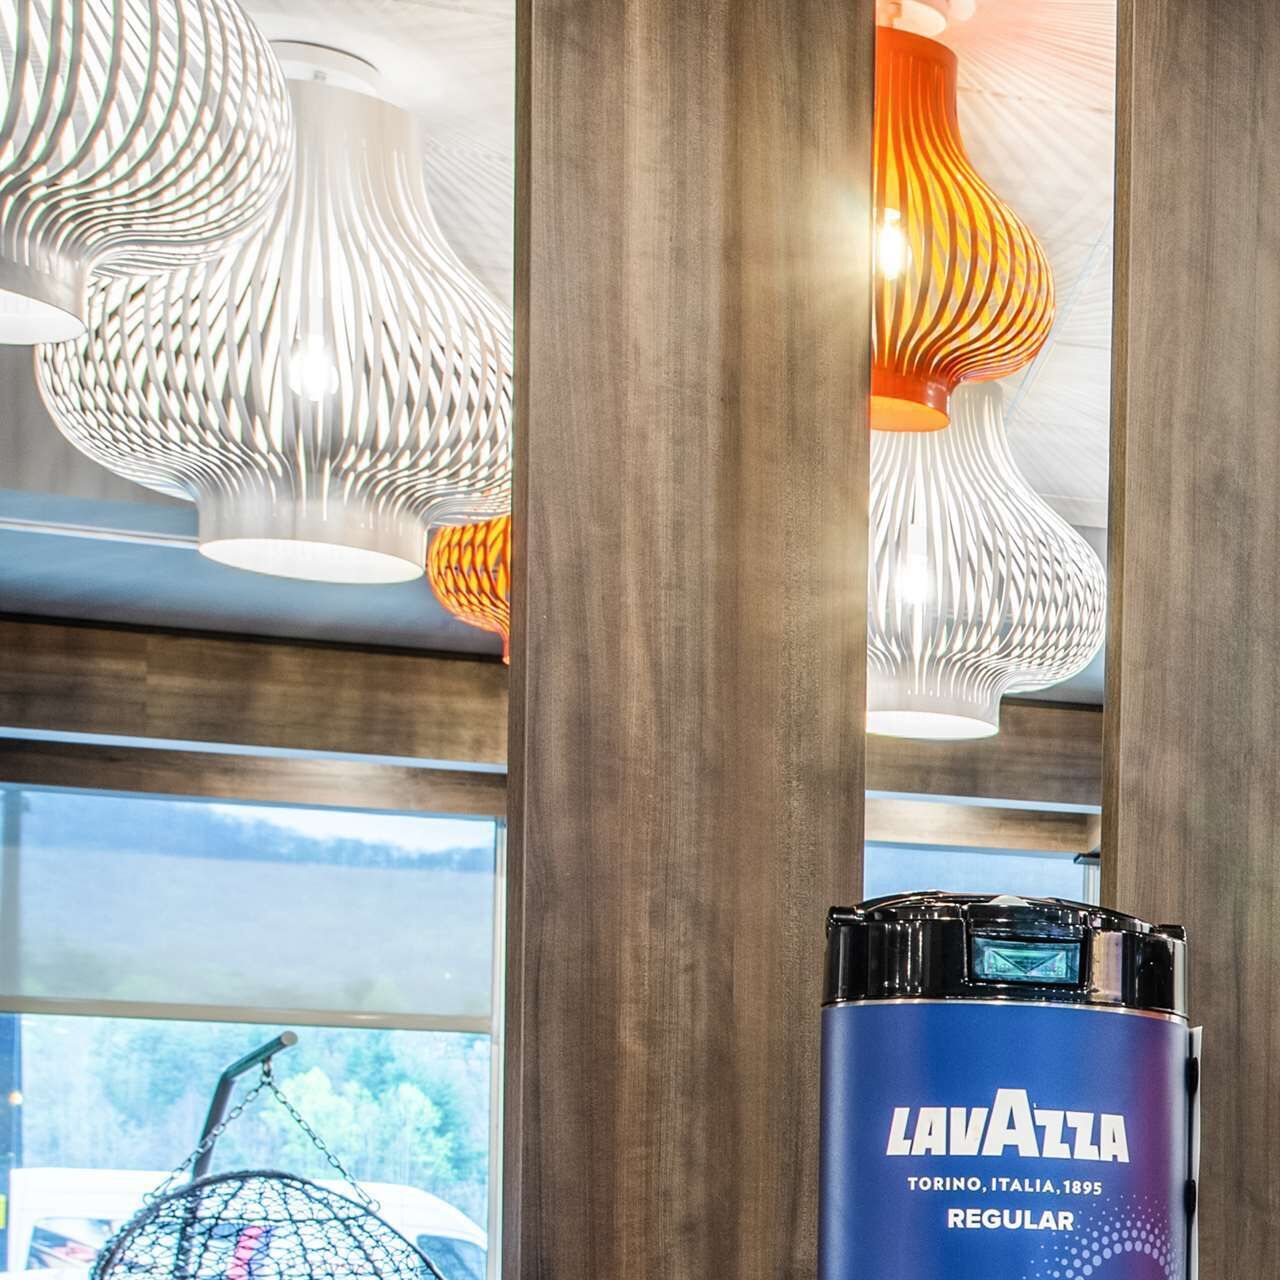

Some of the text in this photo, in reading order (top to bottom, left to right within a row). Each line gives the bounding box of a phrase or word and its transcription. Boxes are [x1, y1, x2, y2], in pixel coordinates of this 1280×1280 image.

[886, 1088, 1130, 1163] LAVAZZA
[907, 1177, 1102, 1196] TORINO, ITALIA, 1895
[947, 1208, 1074, 1231] REGULAR
